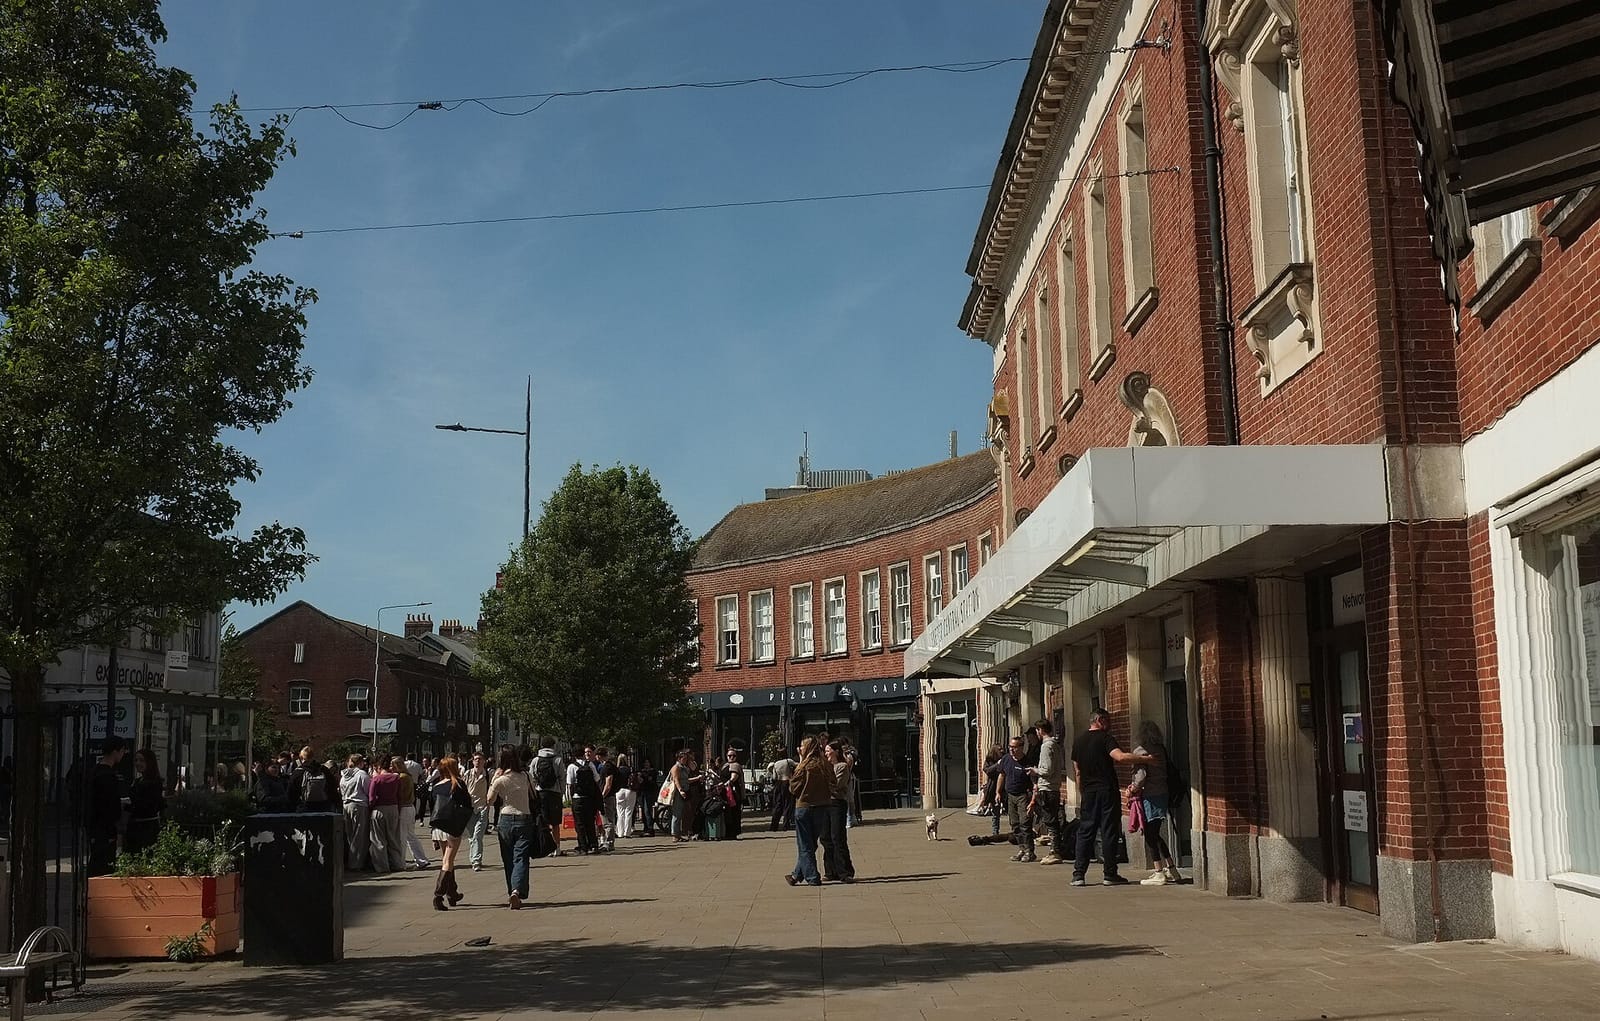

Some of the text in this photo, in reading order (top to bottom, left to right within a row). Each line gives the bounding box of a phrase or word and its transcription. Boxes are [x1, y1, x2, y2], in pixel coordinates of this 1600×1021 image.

[96, 664, 129, 683] exter
[769, 690, 817, 702] PIZZA
[114, 726, 128, 734] top
